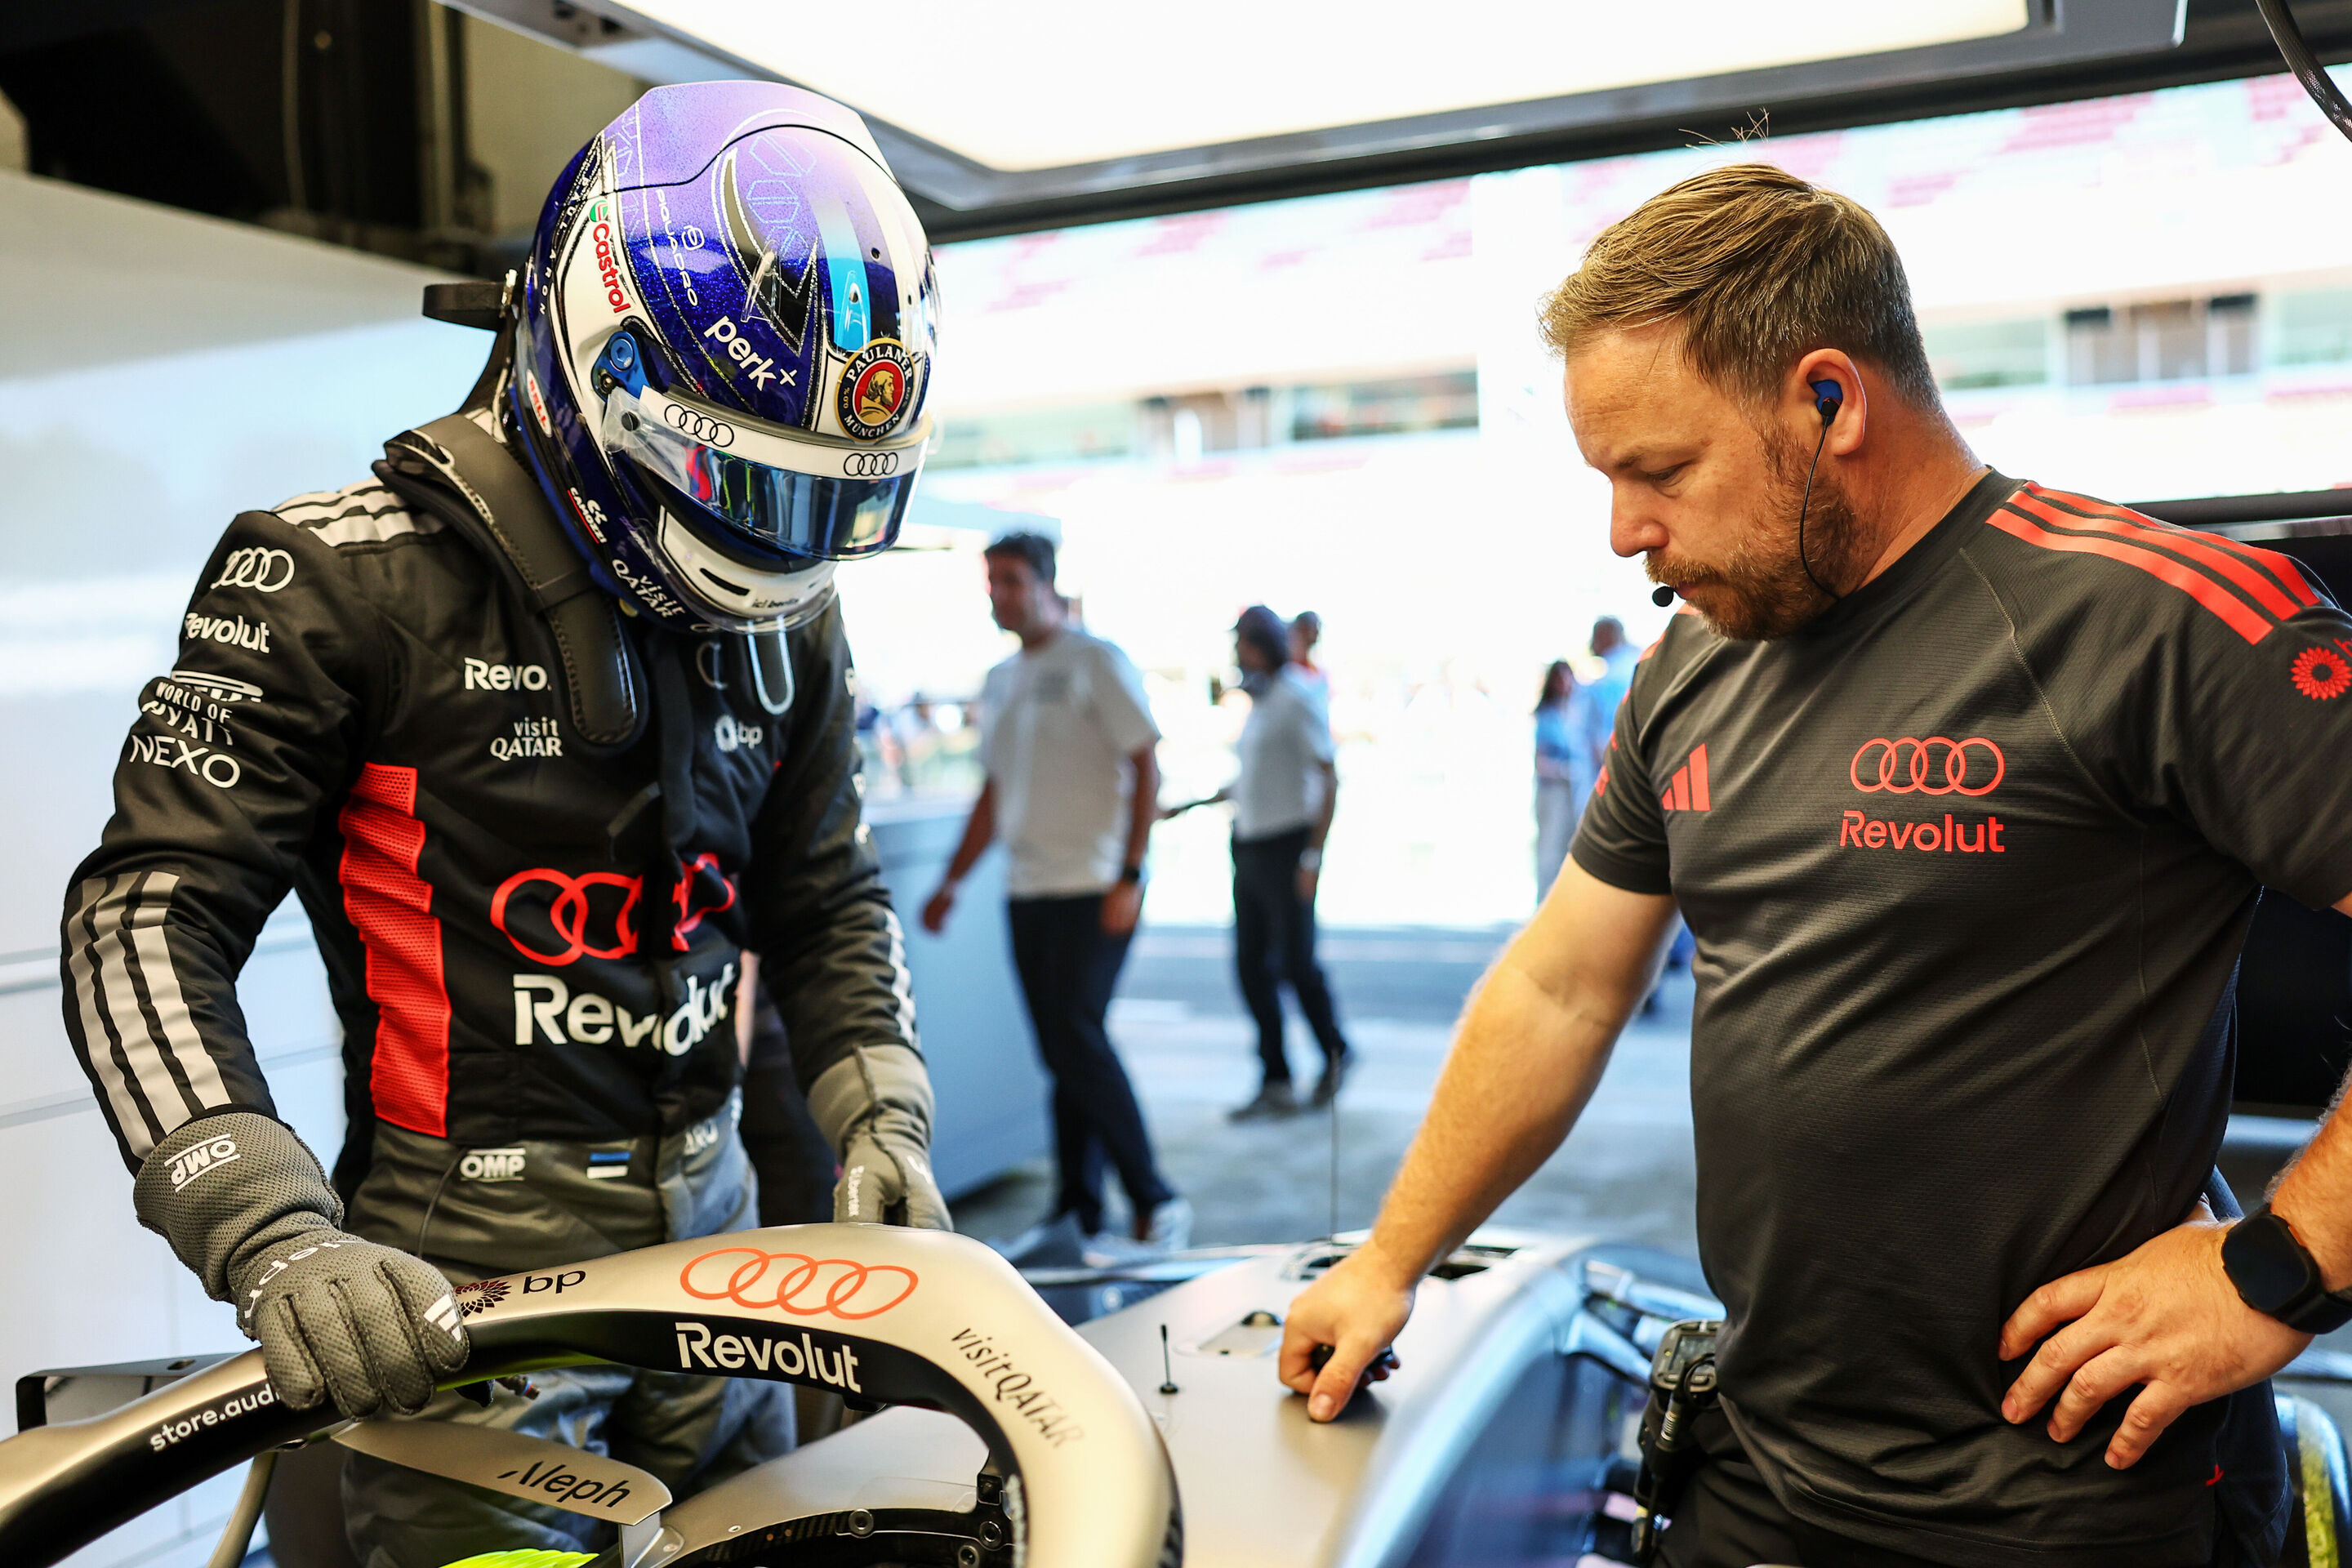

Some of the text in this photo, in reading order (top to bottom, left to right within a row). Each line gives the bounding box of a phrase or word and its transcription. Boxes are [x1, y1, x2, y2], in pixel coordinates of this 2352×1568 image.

[539, 248, 557, 314] ARON
[593, 222, 632, 314] Castrol
[846, 345, 913, 382] PAULANER
[844, 414, 900, 438] MÜNCHEN
[570, 487, 608, 543] CAMOZZI
[612, 559, 674, 618] QATAR
[640, 575, 685, 615] visit
[464, 657, 552, 692] Revo
[156, 681, 202, 712] WORLD
[207, 703, 233, 724] OF
[514, 716, 559, 737] visit
[737, 720, 764, 750] bp
[129, 735, 241, 789] NEXO
[490, 737, 564, 761] QATAR
[1840, 810, 2005, 852] Revolut
[513, 962, 734, 1056] Revolut
[171, 1140, 236, 1185] OMP
[460, 1155, 526, 1178] OMP
[523, 1270, 586, 1294] bp
[675, 1322, 862, 1394] Revolut
[497, 1460, 630, 1508] Aleph
